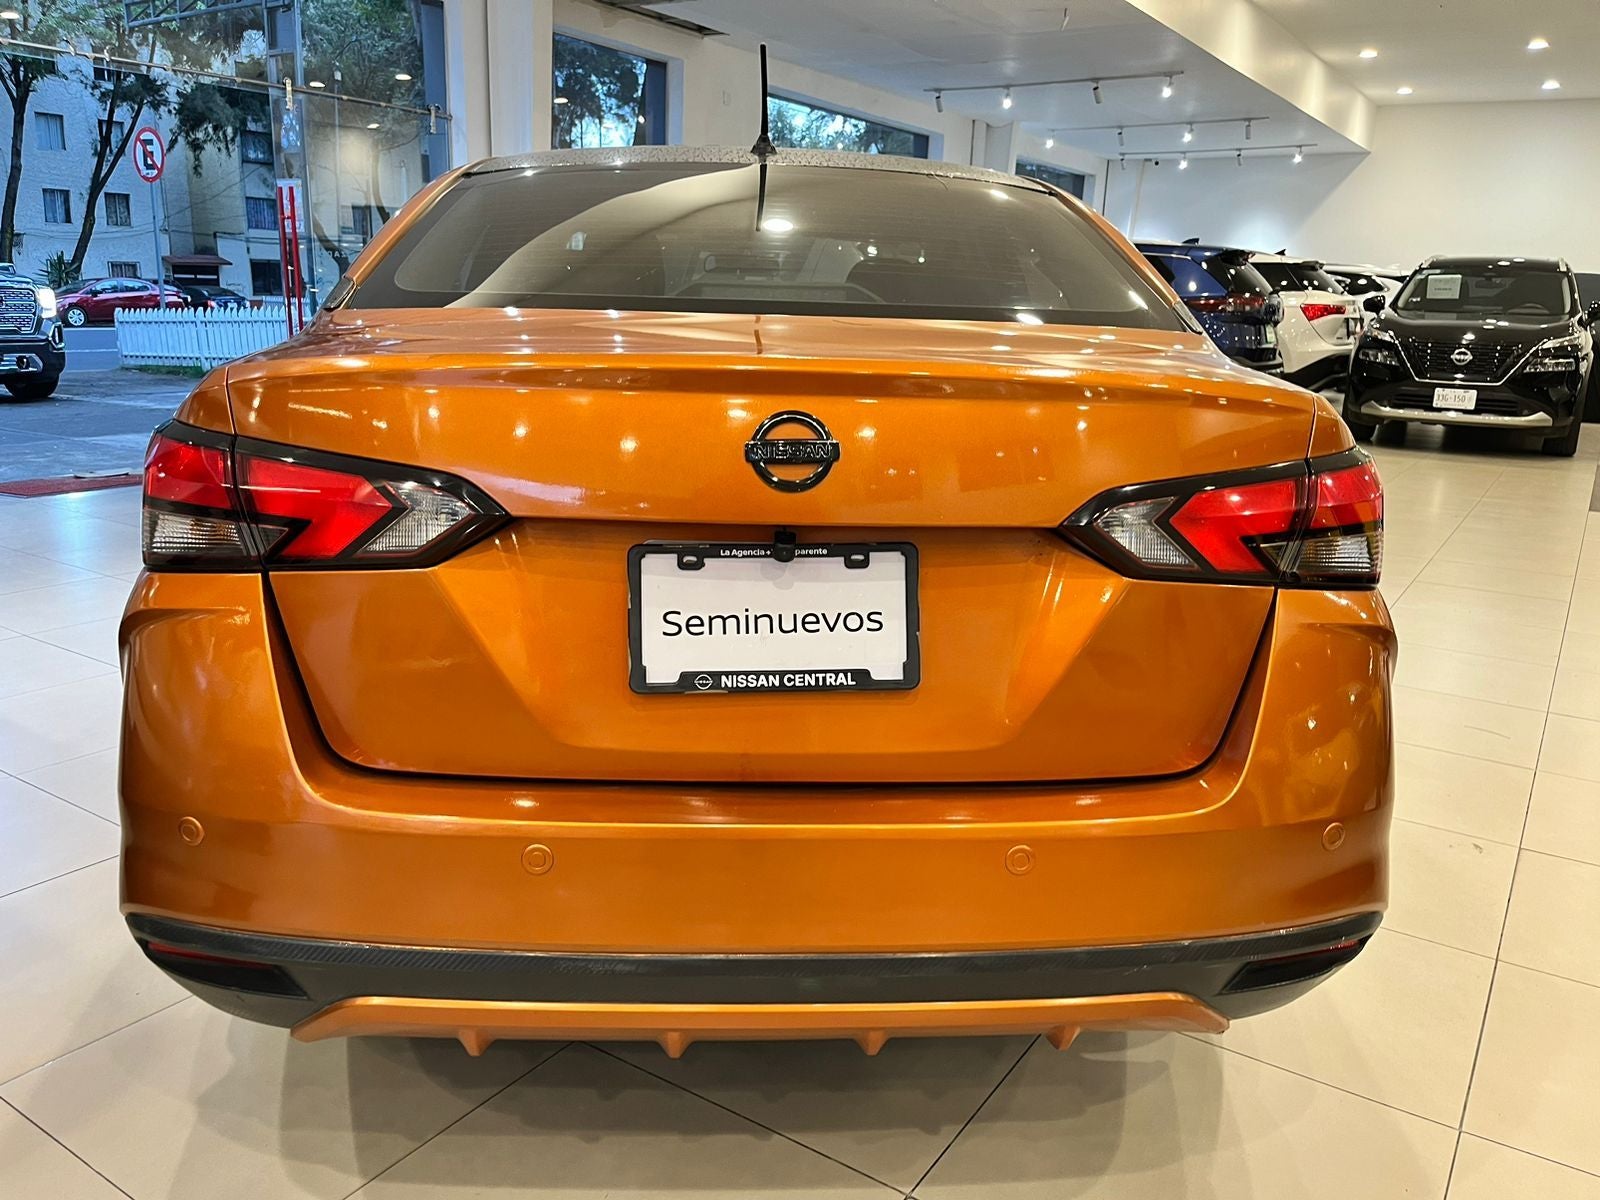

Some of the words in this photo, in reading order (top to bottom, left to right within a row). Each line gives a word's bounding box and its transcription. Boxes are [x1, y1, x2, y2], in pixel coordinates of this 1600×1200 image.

[755, 444, 831, 459] NISSAN
[731, 548, 765, 557] Agencia
[662, 608, 884, 636] Seminuevos
[720, 674, 780, 688] NISSAN
[783, 672, 856, 687] CENTRAL
